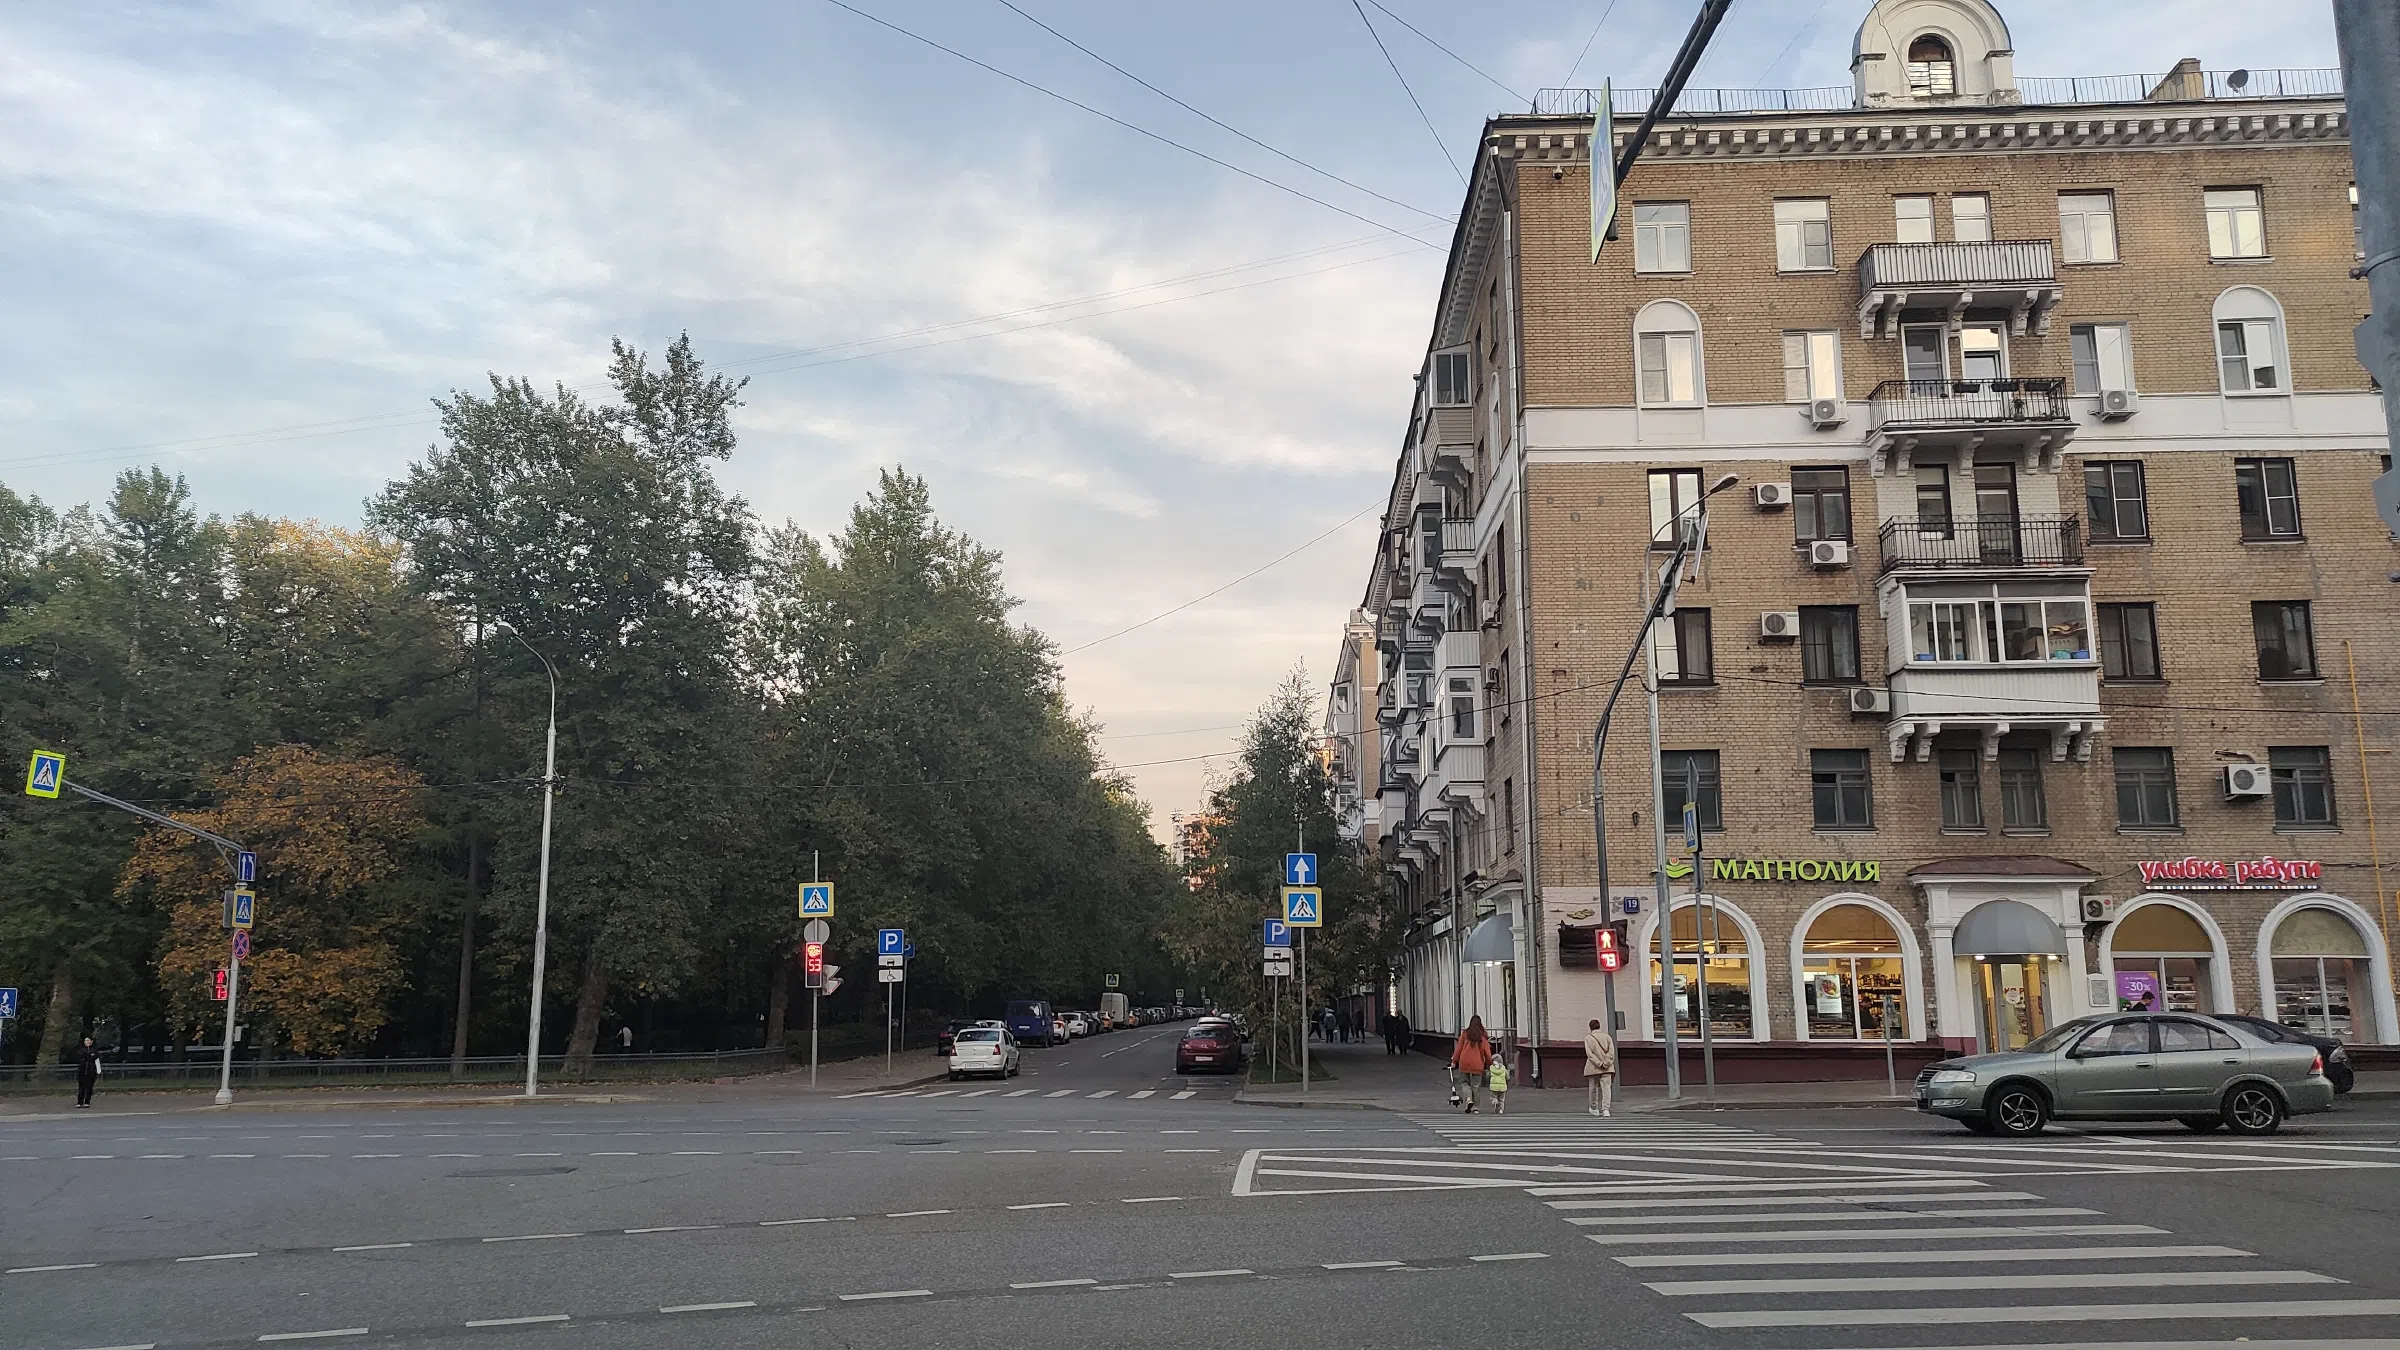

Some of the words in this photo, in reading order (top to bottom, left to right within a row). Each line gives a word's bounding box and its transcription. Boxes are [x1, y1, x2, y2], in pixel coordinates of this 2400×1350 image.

[1712, 859, 1881, 882] МАГНОЛИЯ
[1628, 900, 1638, 908] 19
[1271, 922, 1286, 942] P
[885, 933, 898, 951] P
[808, 959, 821, 971] 53
[2124, 981, 2151, 991] -30%
